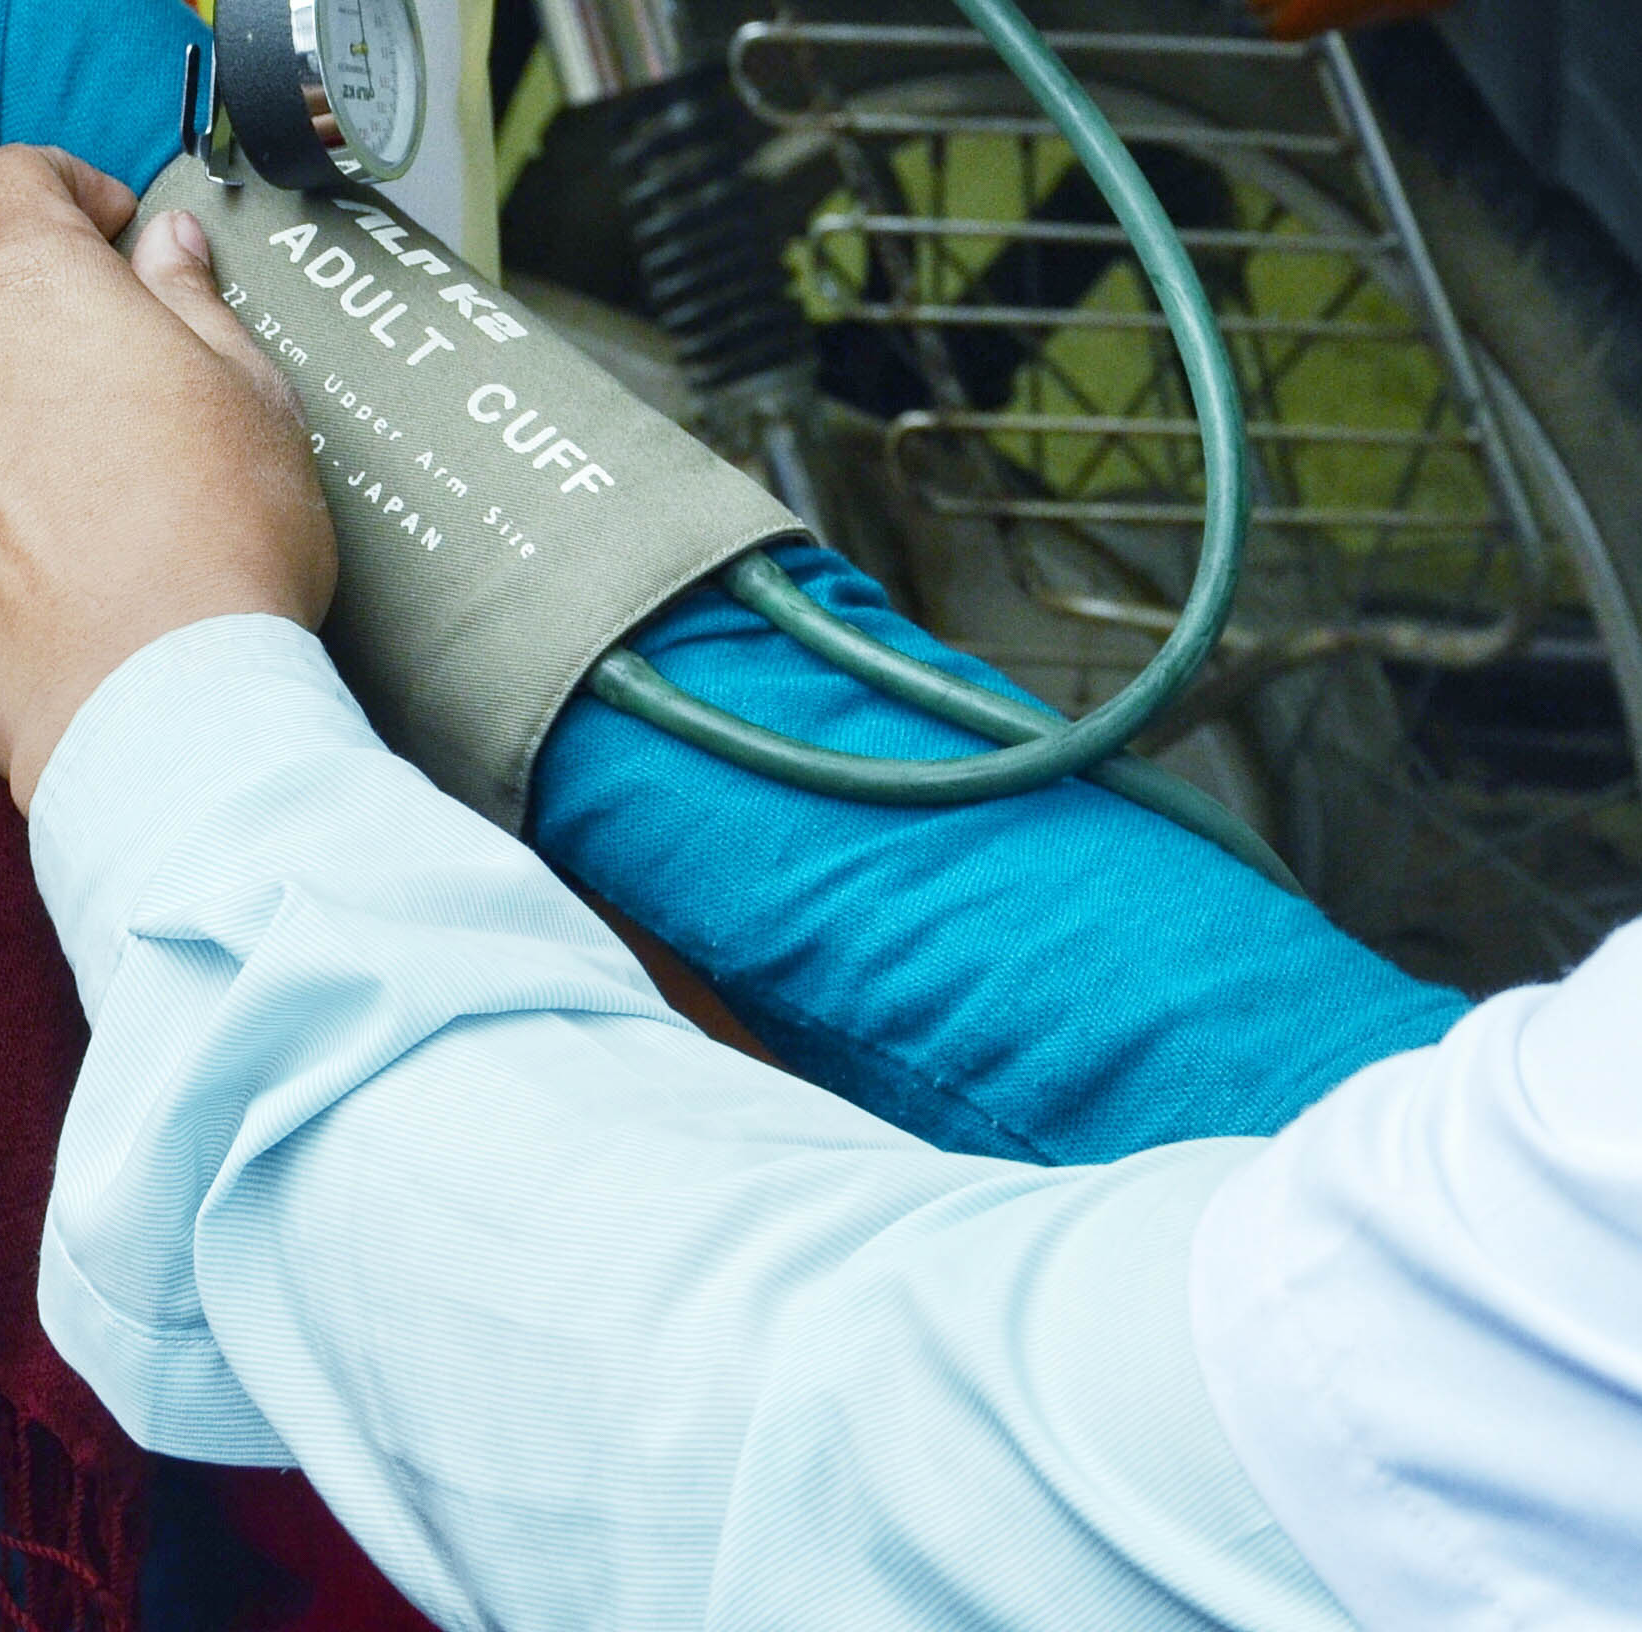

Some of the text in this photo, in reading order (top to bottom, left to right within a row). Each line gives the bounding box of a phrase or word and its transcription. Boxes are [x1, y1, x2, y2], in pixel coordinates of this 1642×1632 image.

[268, 223, 615, 495] ADULT CUFF
[323, 373, 403, 442] Upper
[415, 451, 469, 498] Arm
[483, 506, 536, 559] Size
[347, 470, 444, 551] JAPAN
